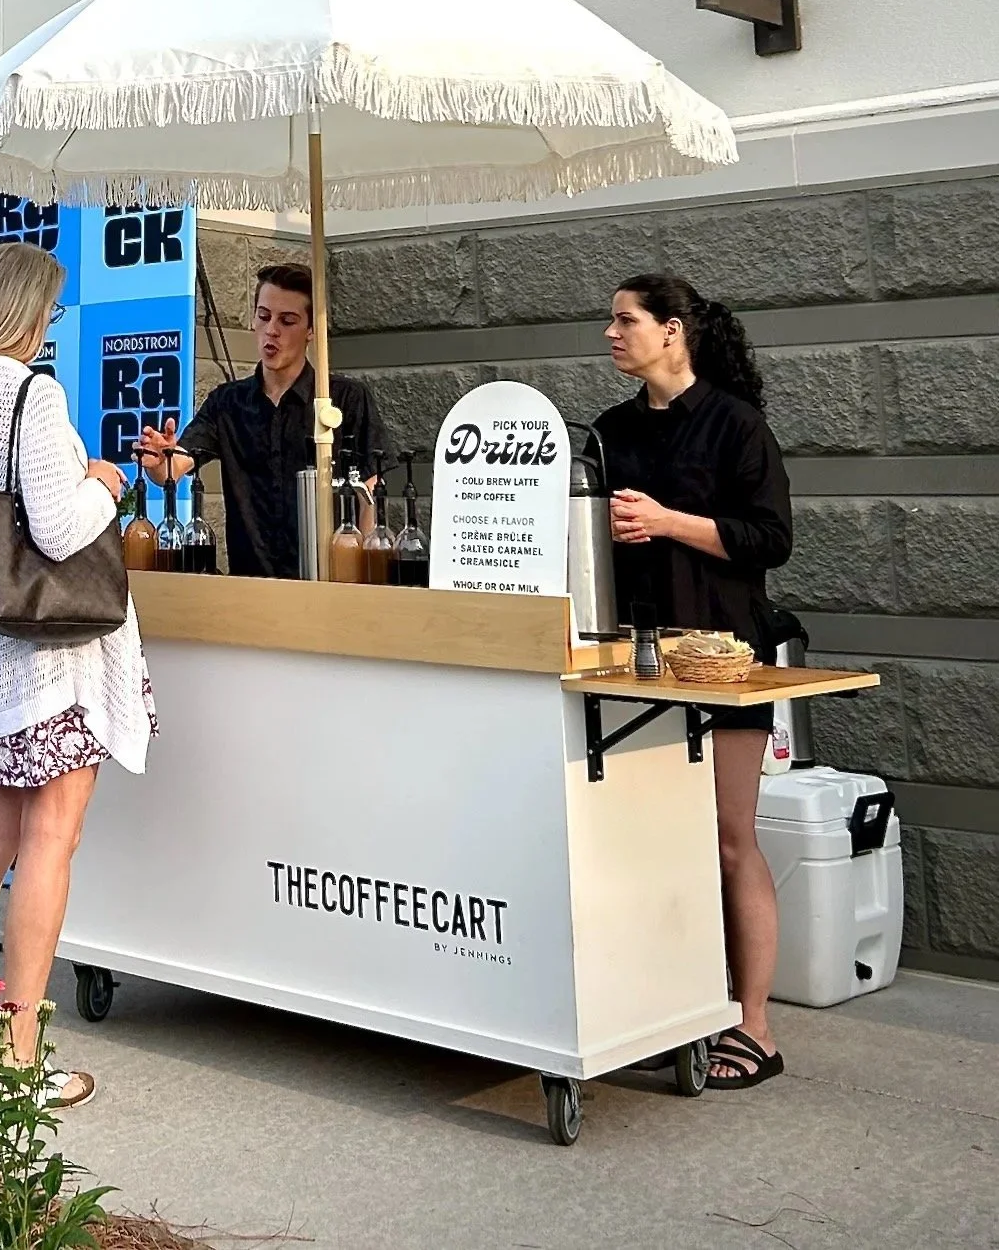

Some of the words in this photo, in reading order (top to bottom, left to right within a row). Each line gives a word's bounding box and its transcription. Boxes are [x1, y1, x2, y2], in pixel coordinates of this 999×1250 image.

[105, 335, 178, 352] NORDSTROM
[493, 421, 517, 430] PICK
[521, 421, 549, 430] YOUR
[445, 423, 557, 465] Drink
[462, 477, 484, 486] COLD
[486, 477, 511, 486] BREW
[514, 477, 539, 487] LATTE
[461, 492, 481, 501] DRIP
[484, 492, 515, 501] COFFEE
[453, 515, 488, 524] CHOOSE
[492, 516, 498, 524] A
[501, 516, 535, 526] FLAVOR
[460, 544, 494, 554] SALTED
[497, 545, 543, 556] CARAMEL
[460, 557, 520, 568] CREAMSICLE
[453, 580, 482, 590] WHOLE
[485, 582, 496, 591] OR
[499, 583, 515, 592] OAT
[518, 584, 539, 594] MILK
[267, 860, 507, 944] THECOFFEECART
[434, 942, 448, 952] BY
[454, 946, 512, 966] JENNINGS
